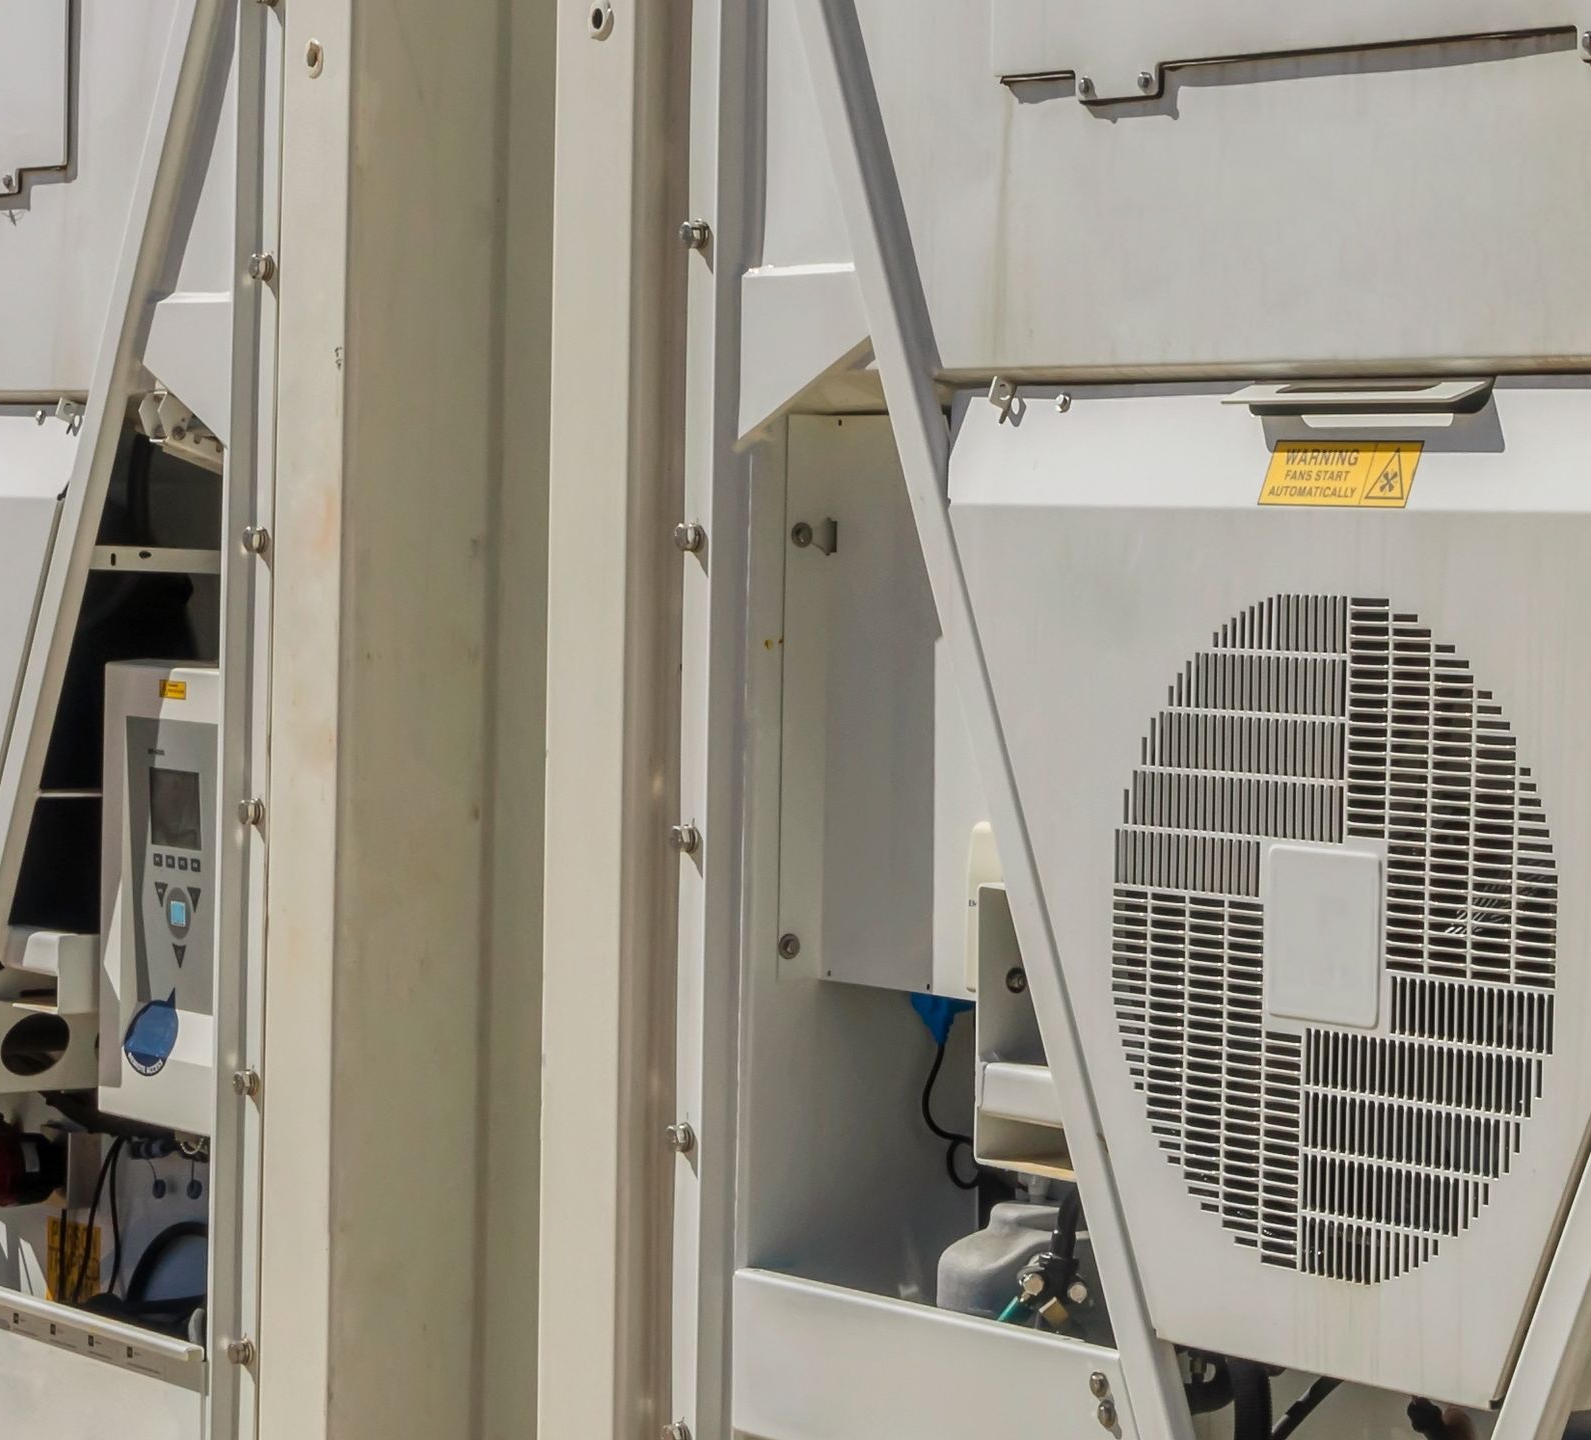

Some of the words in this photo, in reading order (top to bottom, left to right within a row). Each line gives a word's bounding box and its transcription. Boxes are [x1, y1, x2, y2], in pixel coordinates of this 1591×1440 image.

[1285, 447, 1360, 466] WARNING
[1284, 470, 1312, 482] FANS
[1314, 470, 1351, 482] START
[1268, 485, 1357, 499] AUTOMATICALLY
